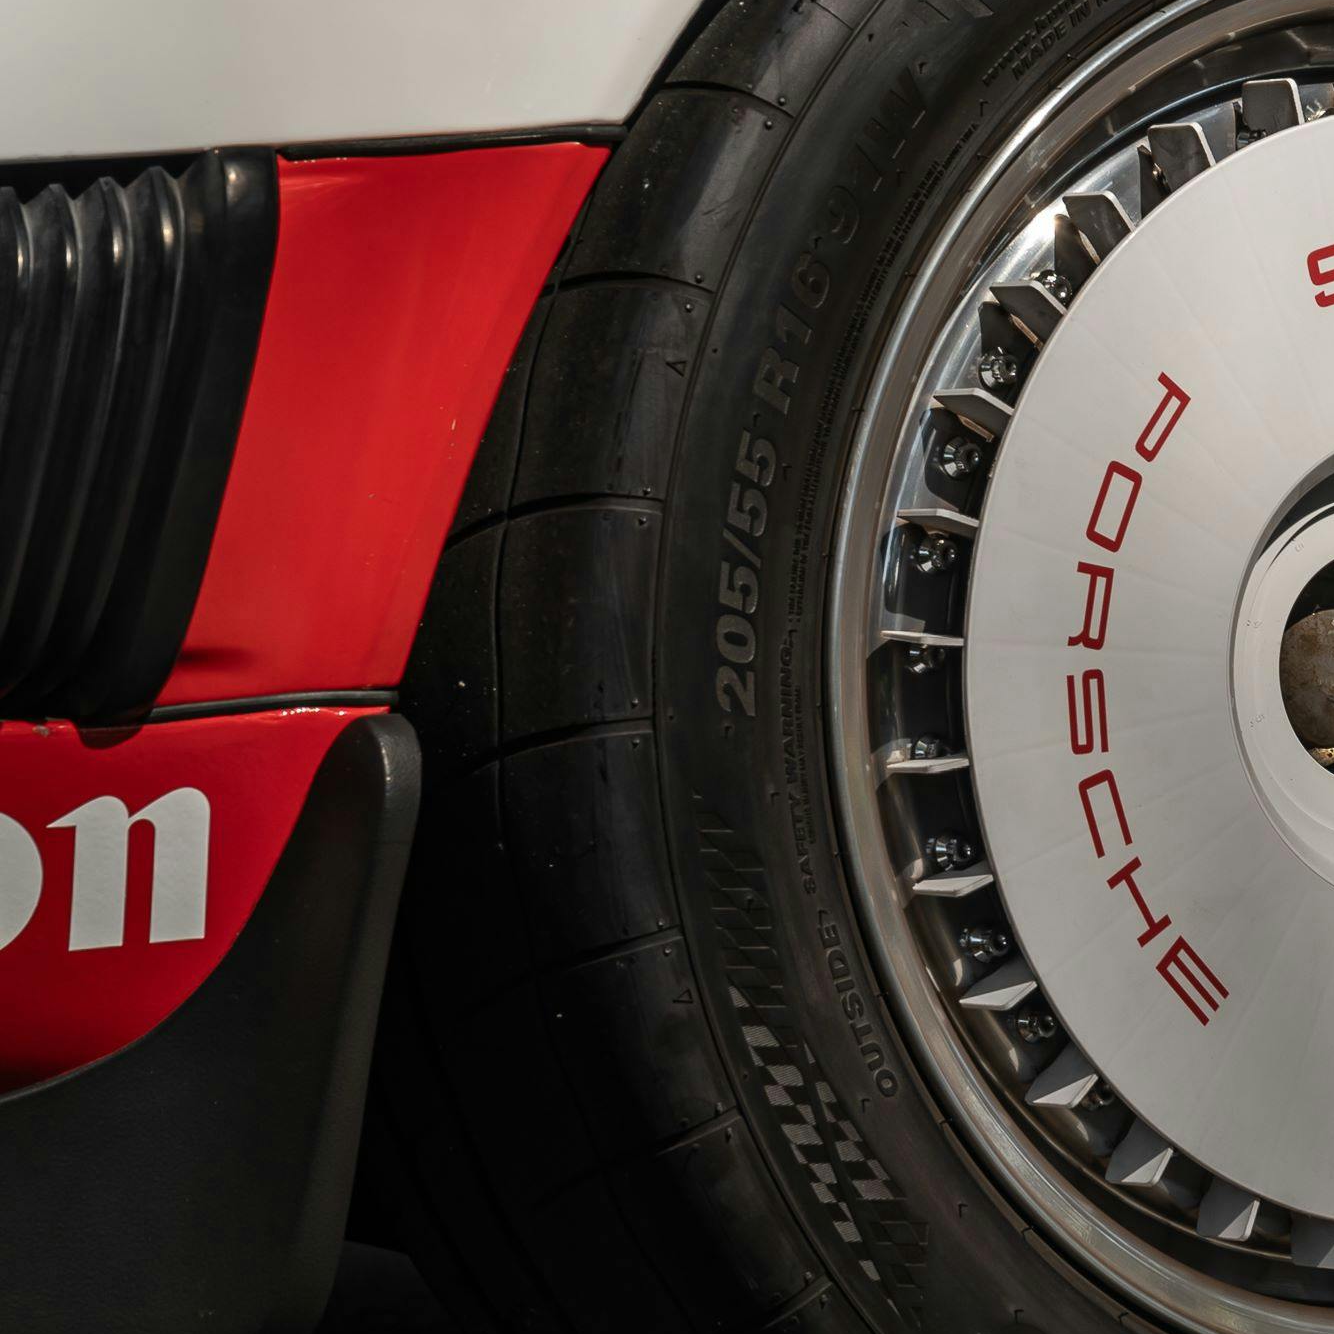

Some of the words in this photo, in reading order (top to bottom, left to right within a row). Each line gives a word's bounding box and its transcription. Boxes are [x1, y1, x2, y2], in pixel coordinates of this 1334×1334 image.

[1011, 16, 1068, 81] MADE
[716, 428, 778, 718] 205/55
[752, 253, 830, 415] R16
[1067, 373, 1226, 1025] PORSCHE
[786, 791, 819, 896] SAFETY
[814, 921, 899, 1099] OUTSIDE
